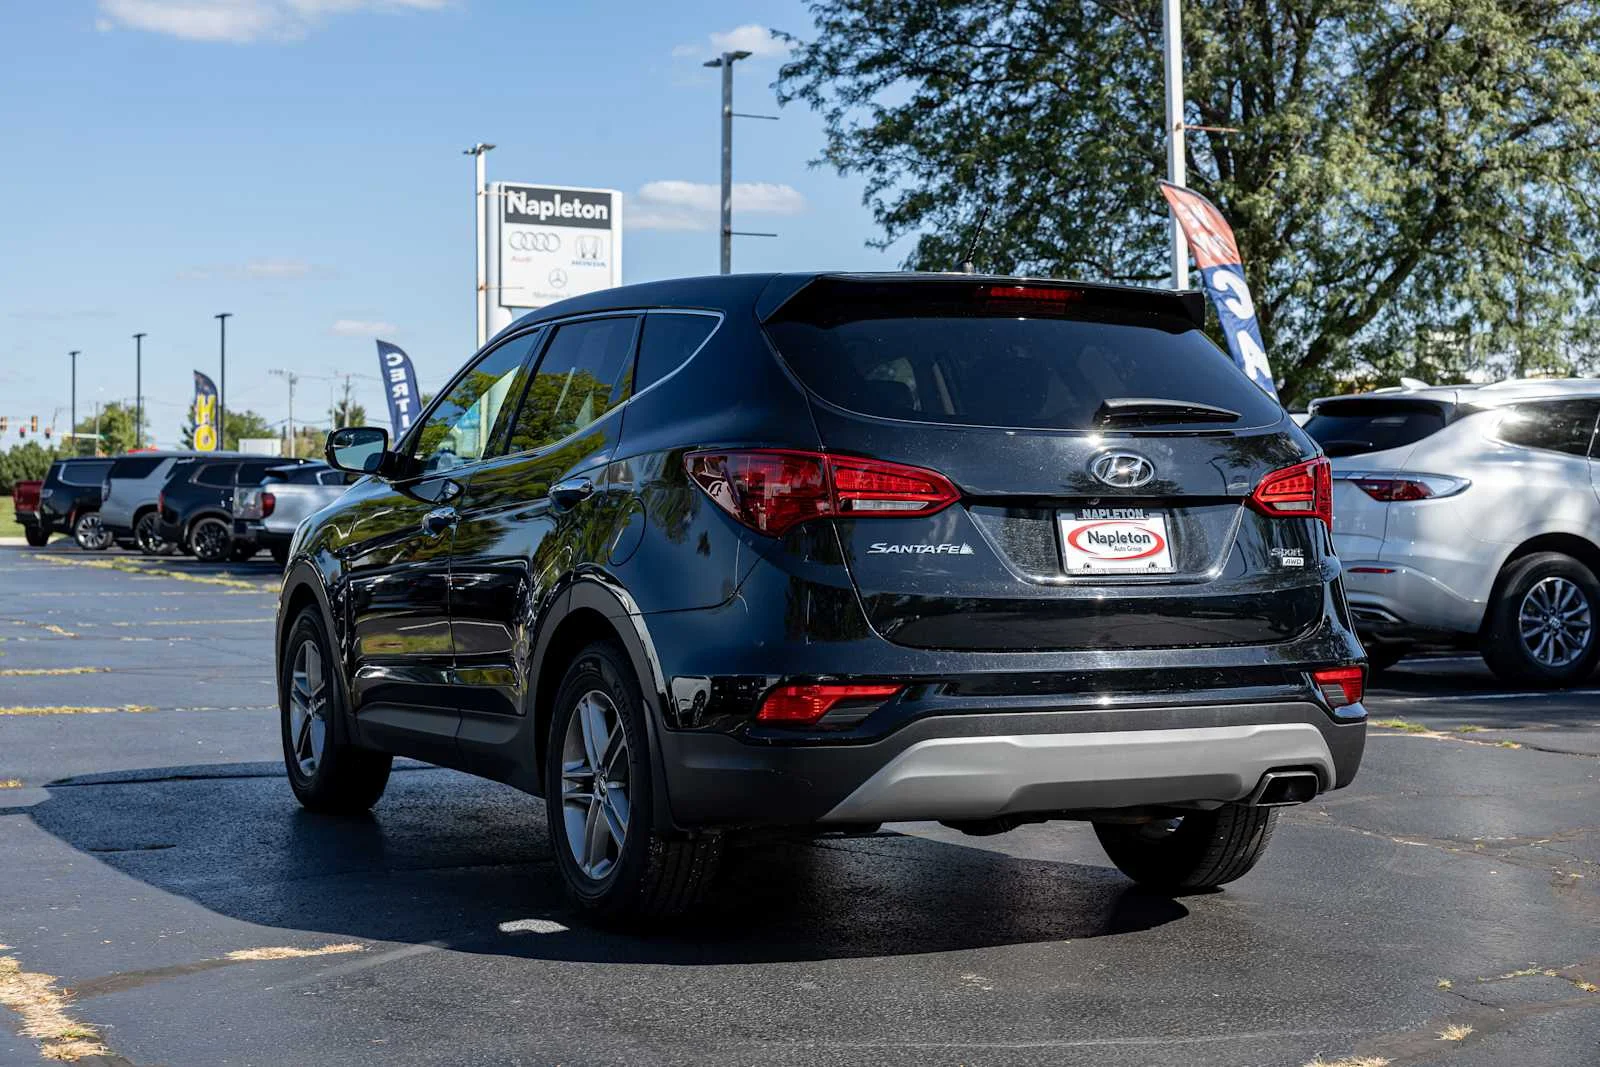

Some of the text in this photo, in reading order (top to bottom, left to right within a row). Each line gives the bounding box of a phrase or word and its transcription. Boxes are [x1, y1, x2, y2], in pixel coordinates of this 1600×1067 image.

[506, 190, 608, 221] Napleton
[1082, 508, 1144, 519] NAPLETON
[1086, 530, 1152, 547] Napleton
